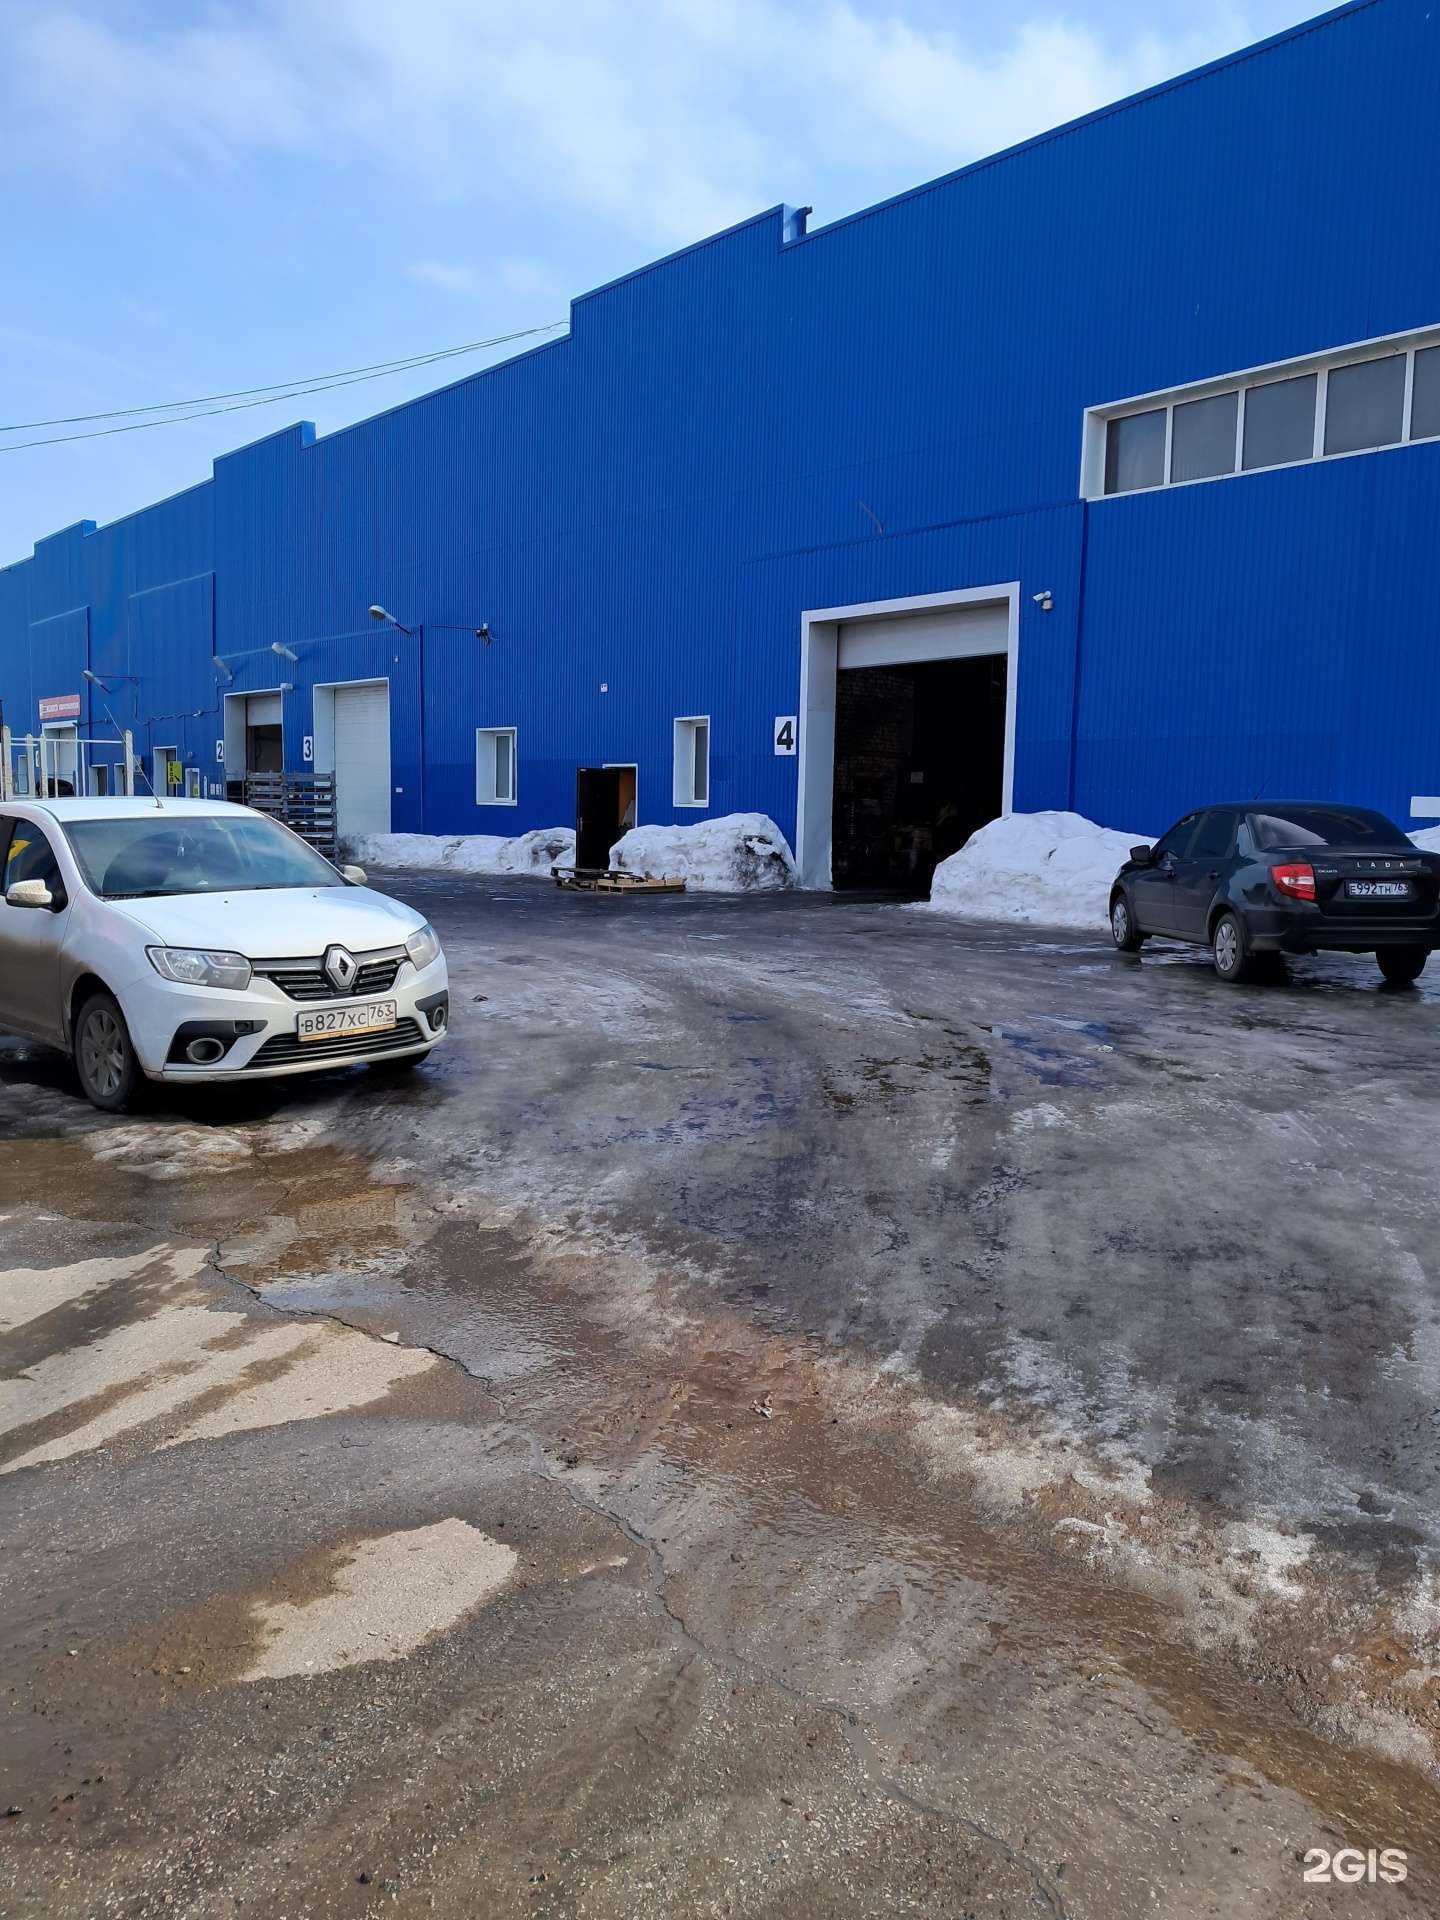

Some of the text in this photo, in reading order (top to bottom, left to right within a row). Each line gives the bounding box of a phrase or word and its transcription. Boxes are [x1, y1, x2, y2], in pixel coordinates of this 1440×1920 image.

[777, 720, 794, 750] 4
[217, 742, 223, 760] 2
[304, 739, 312, 758] 3
[1356, 861, 1405, 869] LADA
